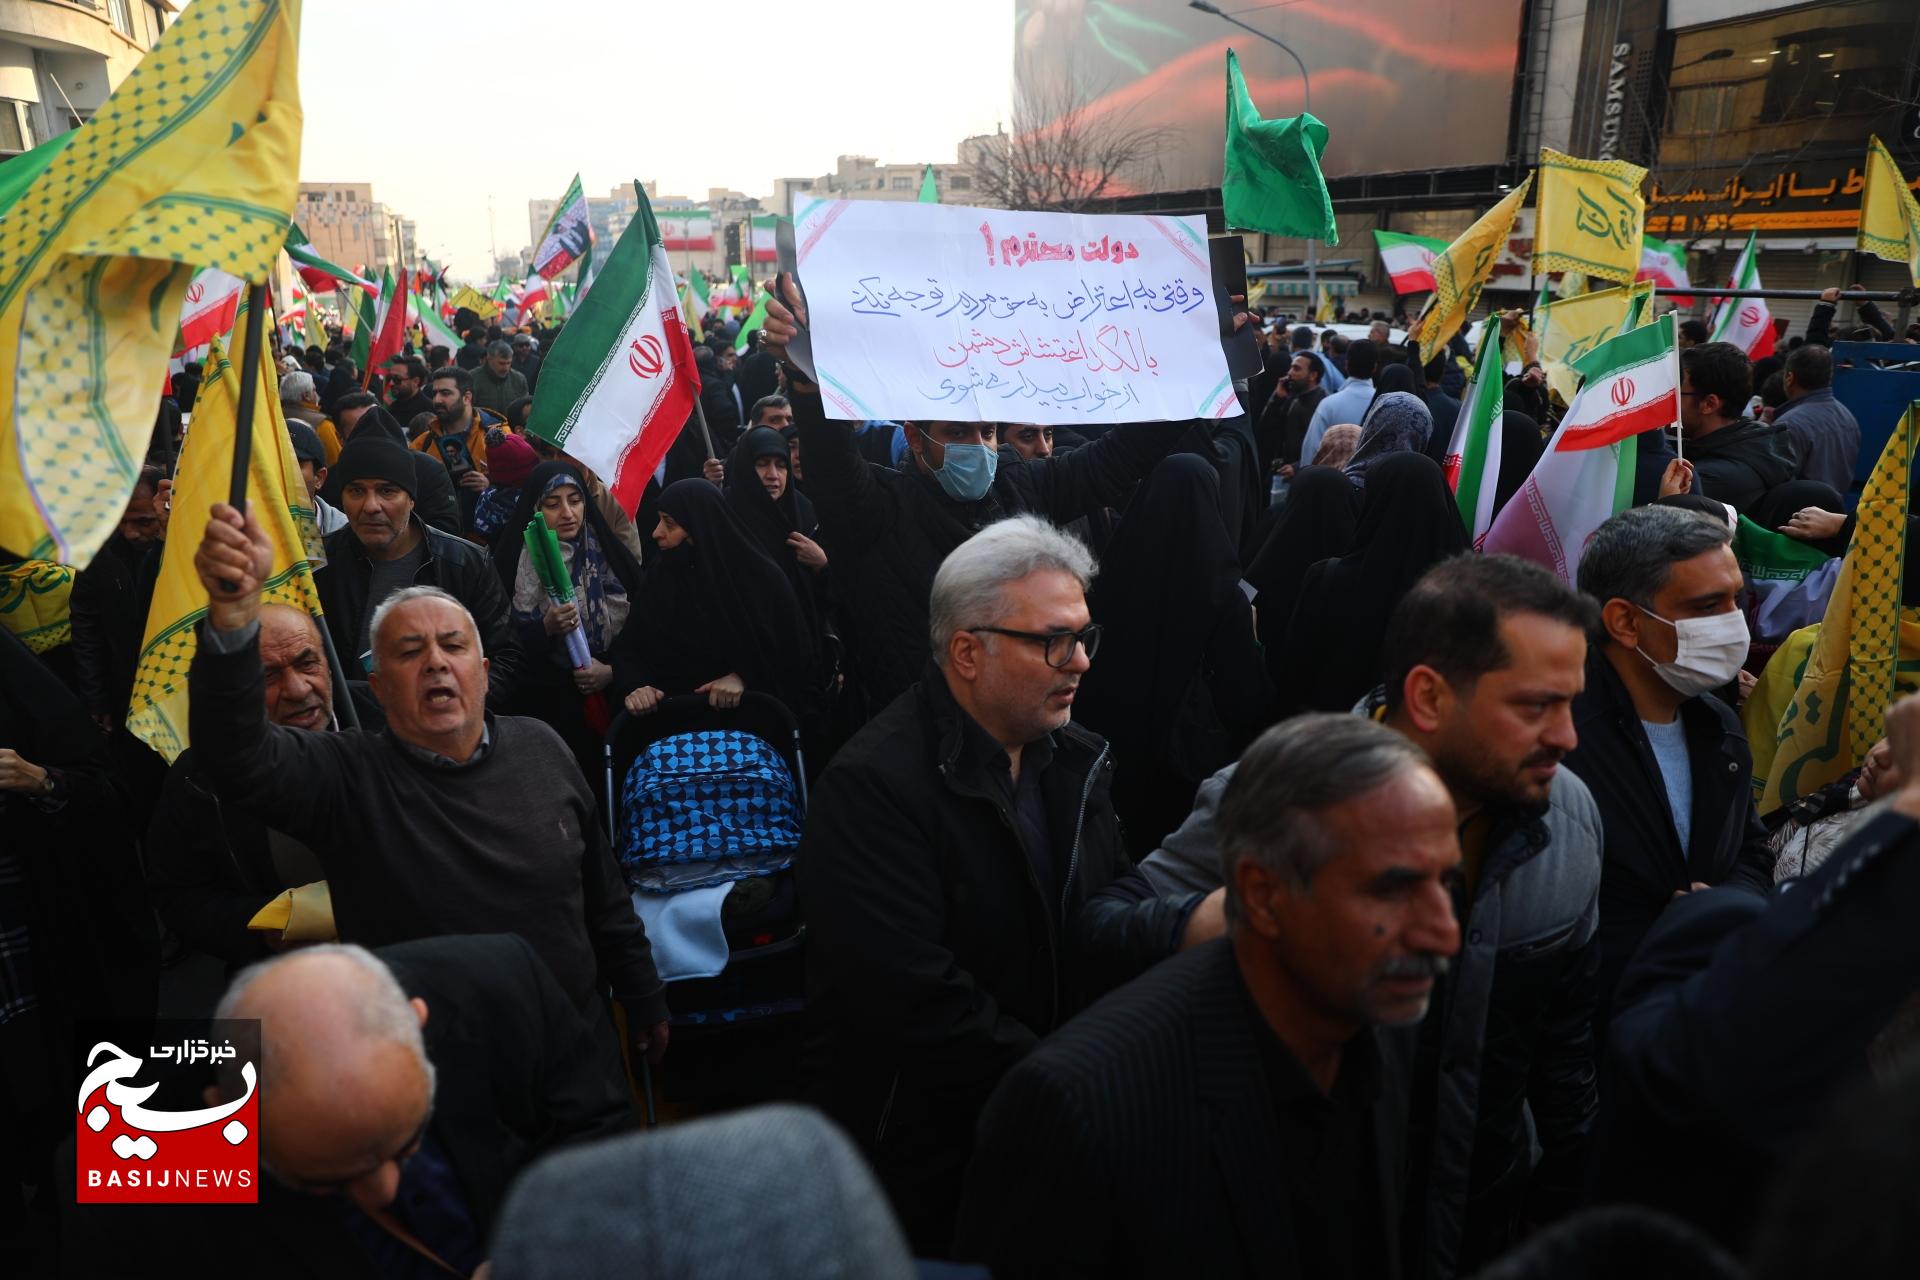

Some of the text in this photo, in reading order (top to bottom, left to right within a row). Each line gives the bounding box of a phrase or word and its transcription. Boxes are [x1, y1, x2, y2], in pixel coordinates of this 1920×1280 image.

[1787, 172, 1837, 204] با
[1081, 235, 1139, 264] دولت
[936, 293, 996, 320] مردم
[989, 296, 1025, 319] حق
[1027, 291, 1048, 318] به
[1053, 279, 1134, 322] اعتراض
[1133, 278, 1157, 310] به
[1149, 278, 1204, 314] وقتی
[933, 324, 1159, 376] با لگد اغتشاش دشمن
[1000, 370, 1068, 410] بیدار
[1052, 376, 1121, 412] خواب
[1114, 383, 1140, 410] از
